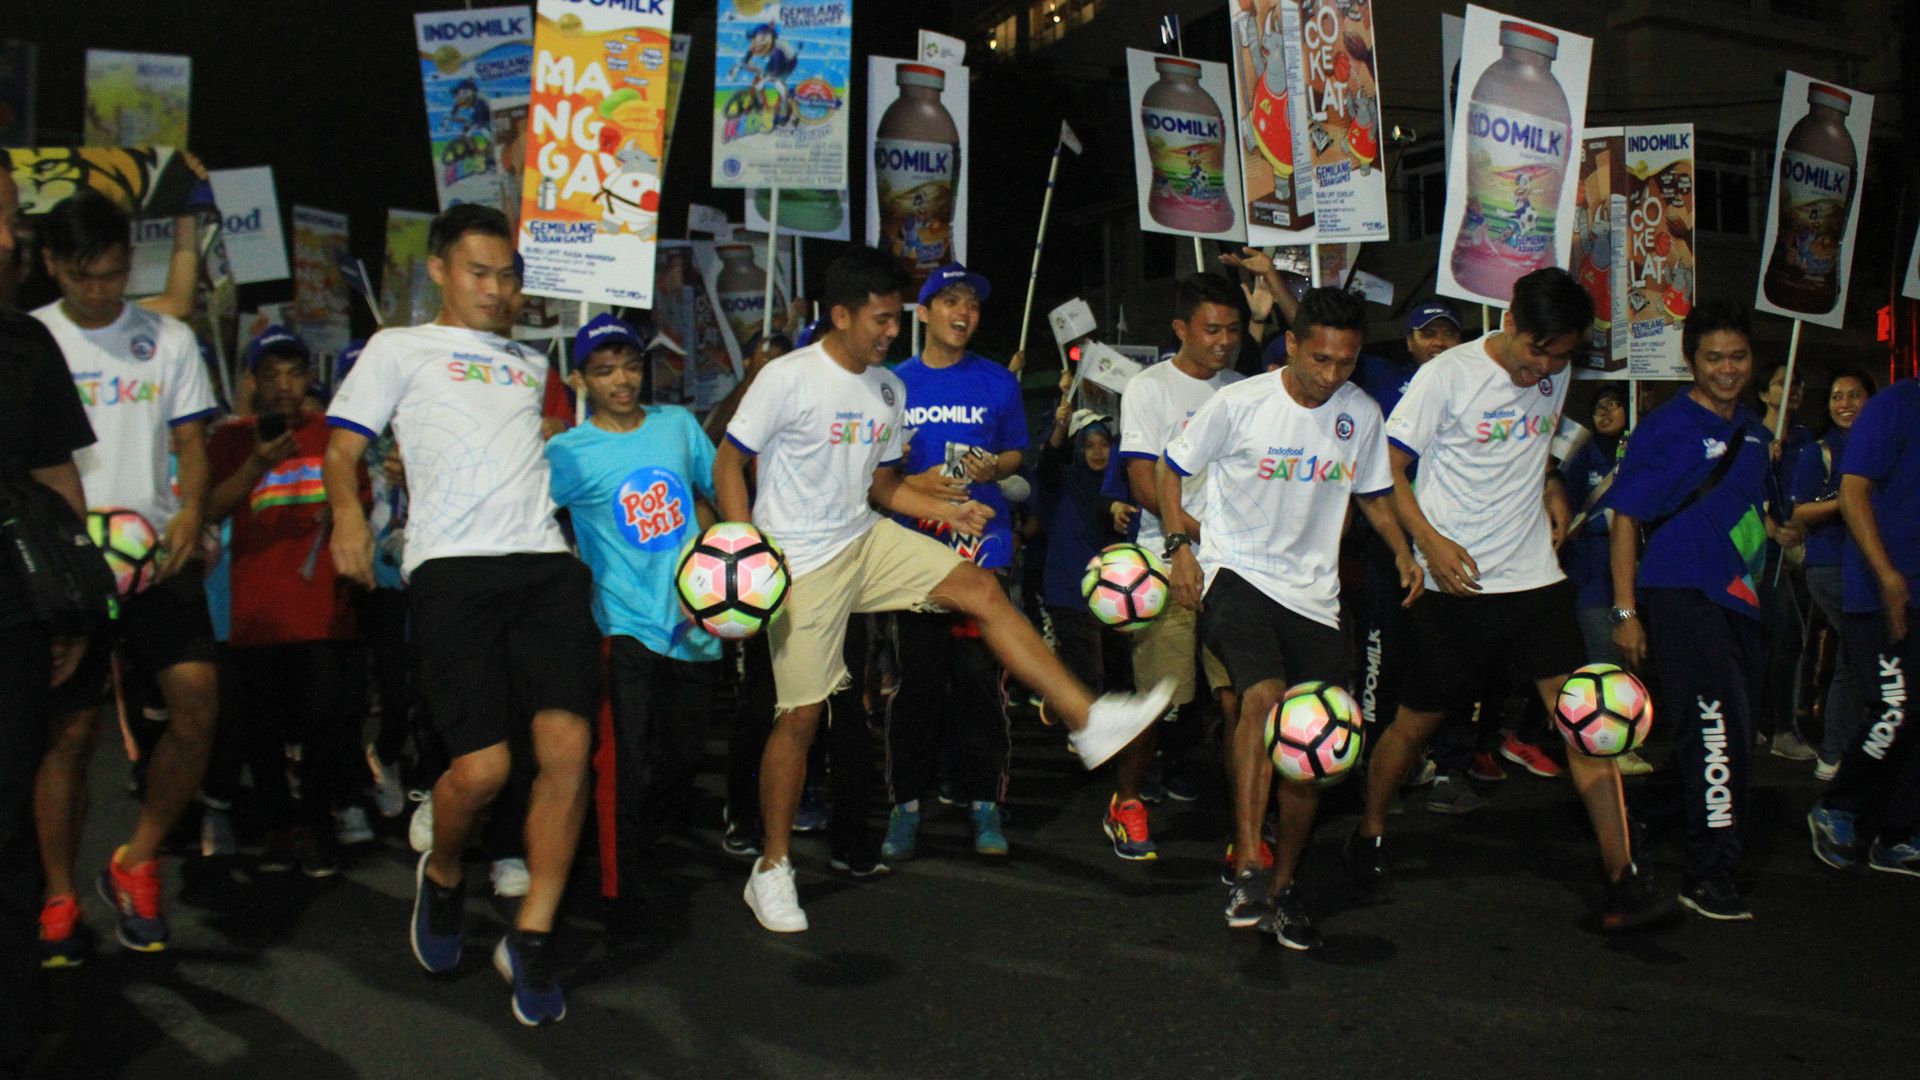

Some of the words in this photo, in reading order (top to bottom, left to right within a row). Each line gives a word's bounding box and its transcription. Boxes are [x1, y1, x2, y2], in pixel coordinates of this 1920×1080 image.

[423, 17, 525, 42] INDOMILK
[1628, 133, 1691, 152] INDOMILK
[530, 221, 597, 234] GEMILANG
[447, 361, 542, 389] SATUKA
[904, 404, 984, 426] NDOMILK
[1267, 446, 1305, 457] Indofood
[620, 481, 668, 525] POP
[638, 498, 684, 543] MIE
[1362, 629, 1382, 723] INDOMILK
[1697, 697, 1733, 828] INDOMILK
